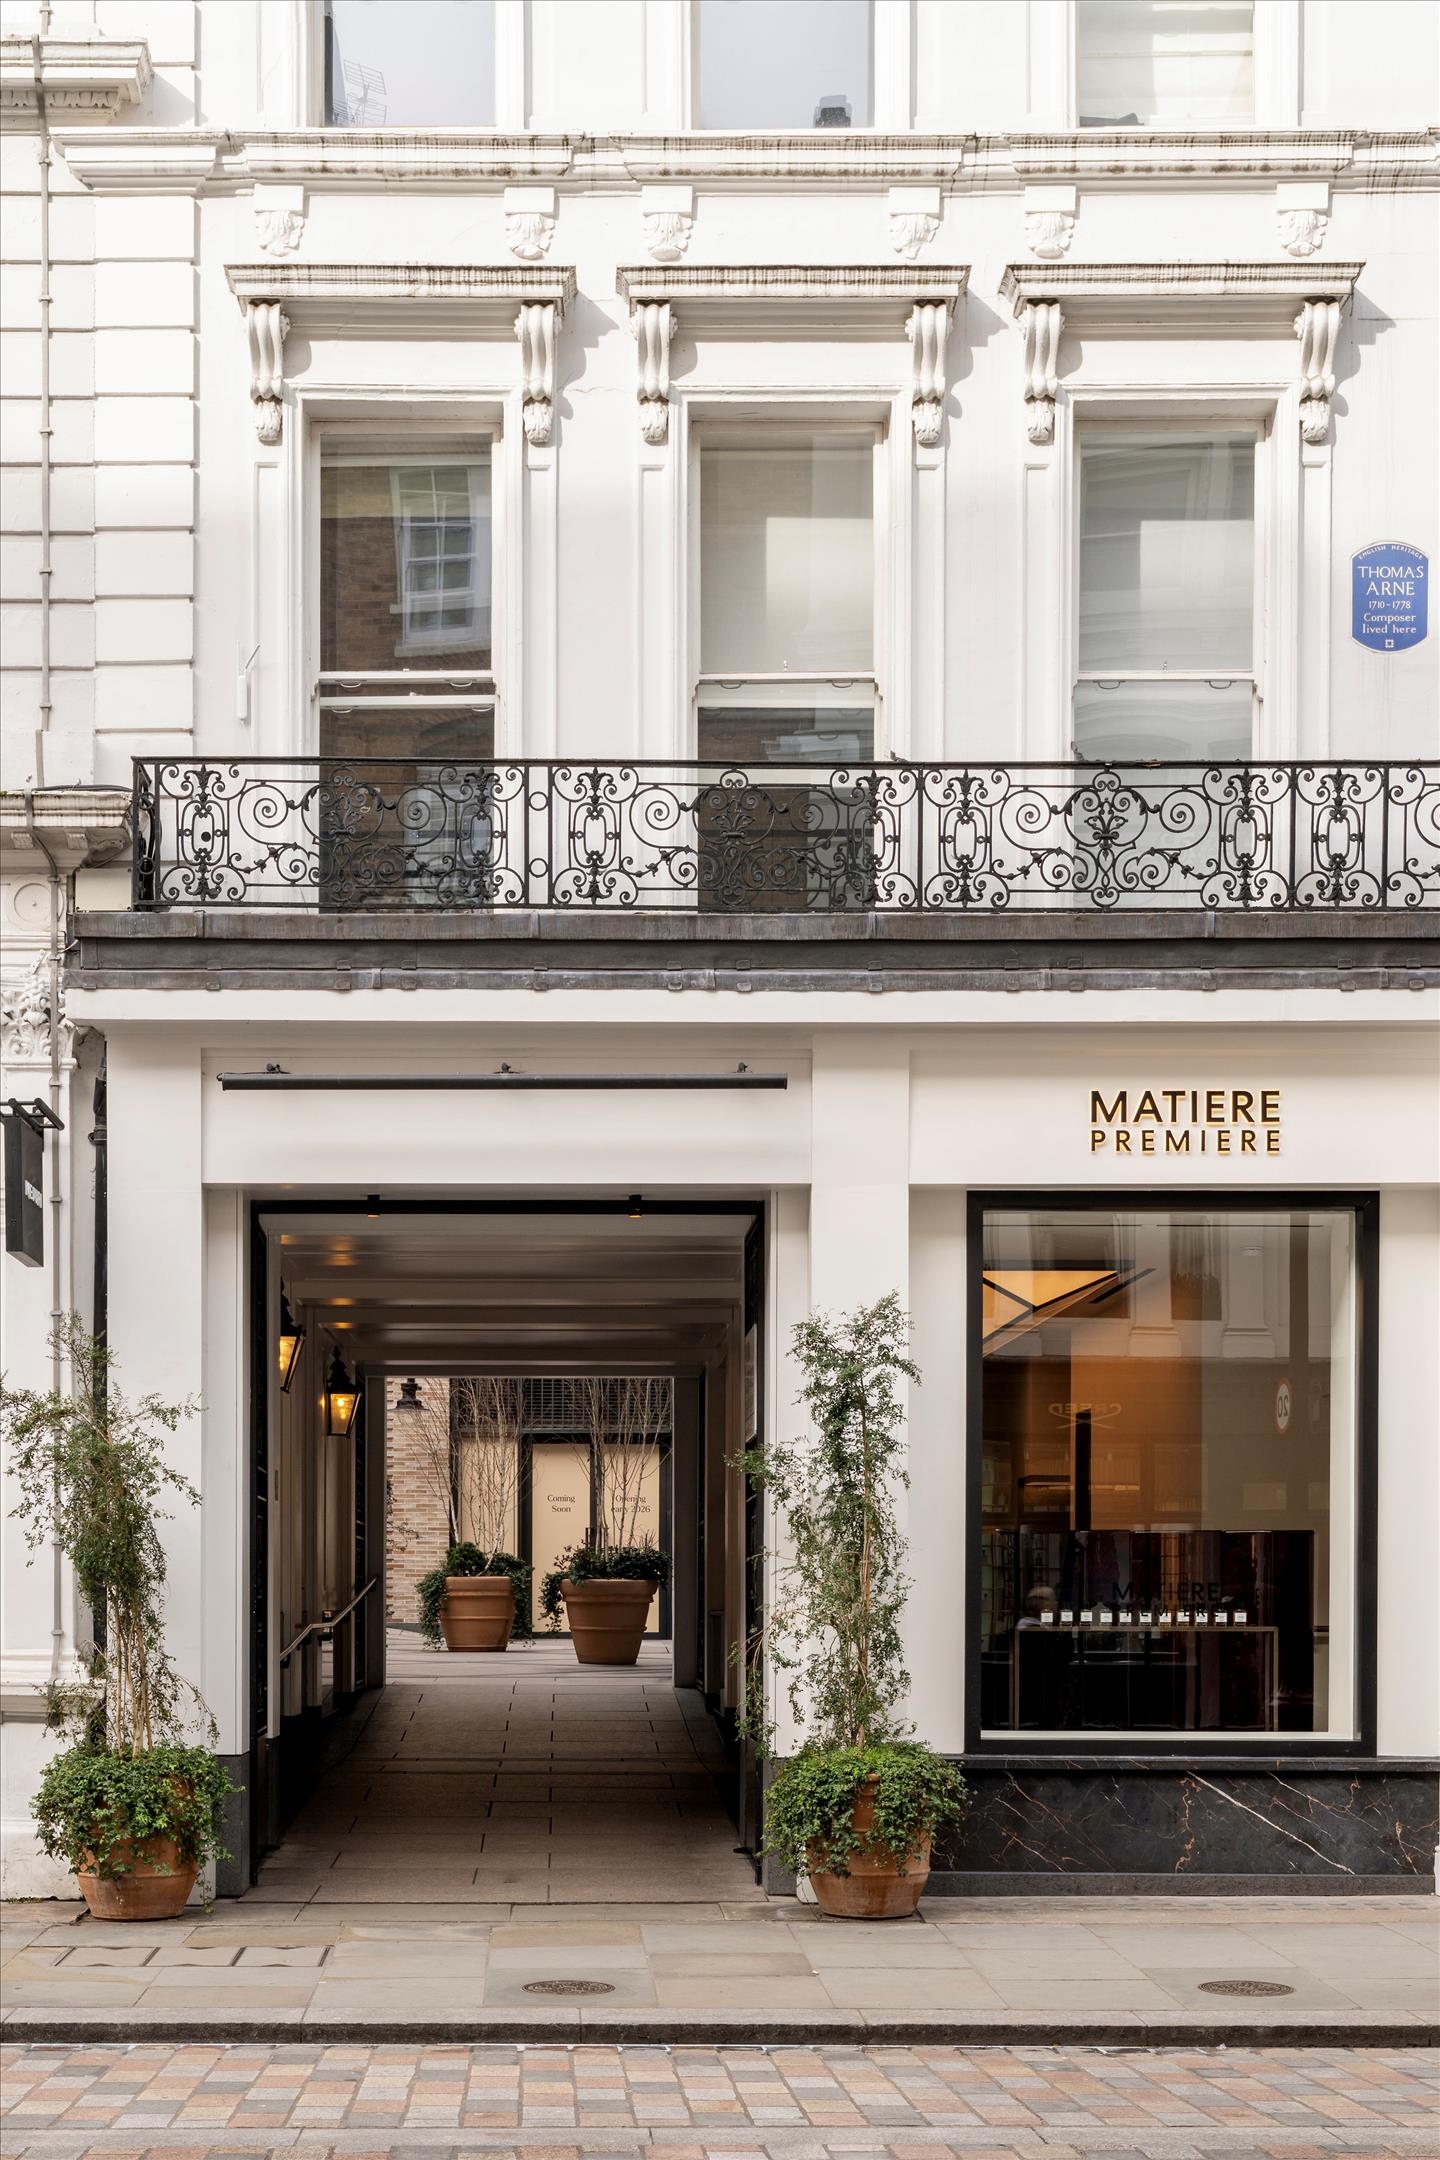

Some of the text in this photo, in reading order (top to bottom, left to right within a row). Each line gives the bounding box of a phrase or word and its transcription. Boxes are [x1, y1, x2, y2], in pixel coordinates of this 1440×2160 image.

[1358, 545, 1423, 561] ENGLISH HERITAGE
[1357, 566, 1424, 578] THOMAS
[1366, 581, 1415, 596] ARNE
[1363, 613, 1417, 624] Composer
[1362, 624, 1417, 634] lived here
[1090, 1090, 1281, 1123] MATIERE
[1090, 1129, 1281, 1152] PREMIERE
[547, 1494, 576, 1504] Coming
[551, 1505, 571, 1513] Soon
